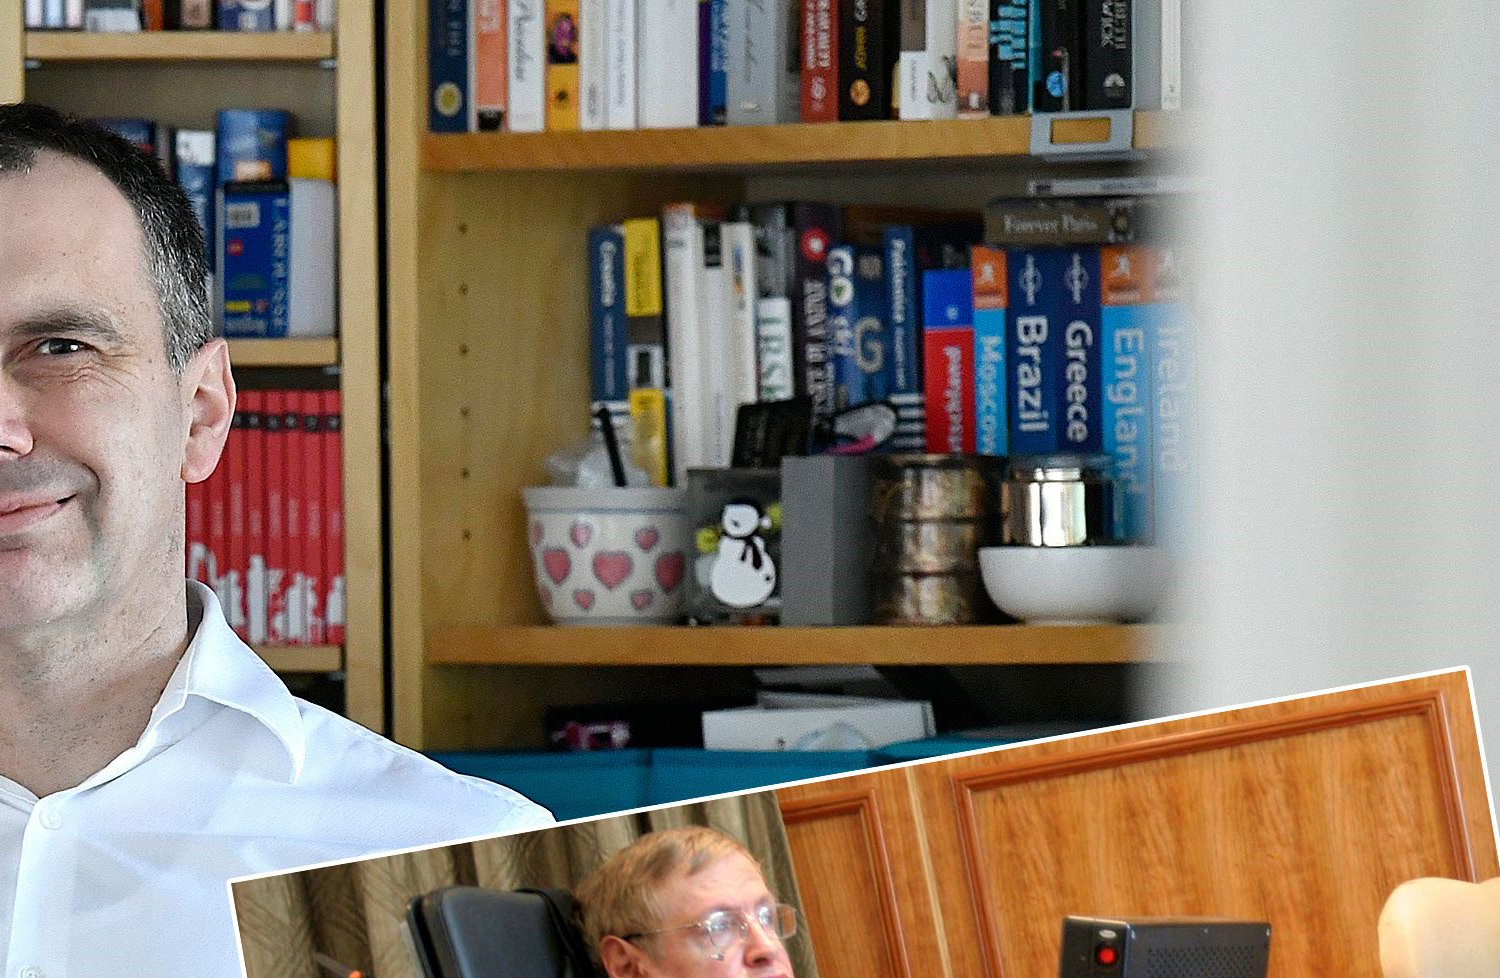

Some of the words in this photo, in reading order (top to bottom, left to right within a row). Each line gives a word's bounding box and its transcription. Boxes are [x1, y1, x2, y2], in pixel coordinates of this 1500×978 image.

[827, 250, 854, 306] GO
[1016, 315, 1050, 434] Brazil
[1065, 320, 1094, 444] Greece
[1109, 327, 1145, 496] England
[1156, 326, 1184, 472] Ireland
